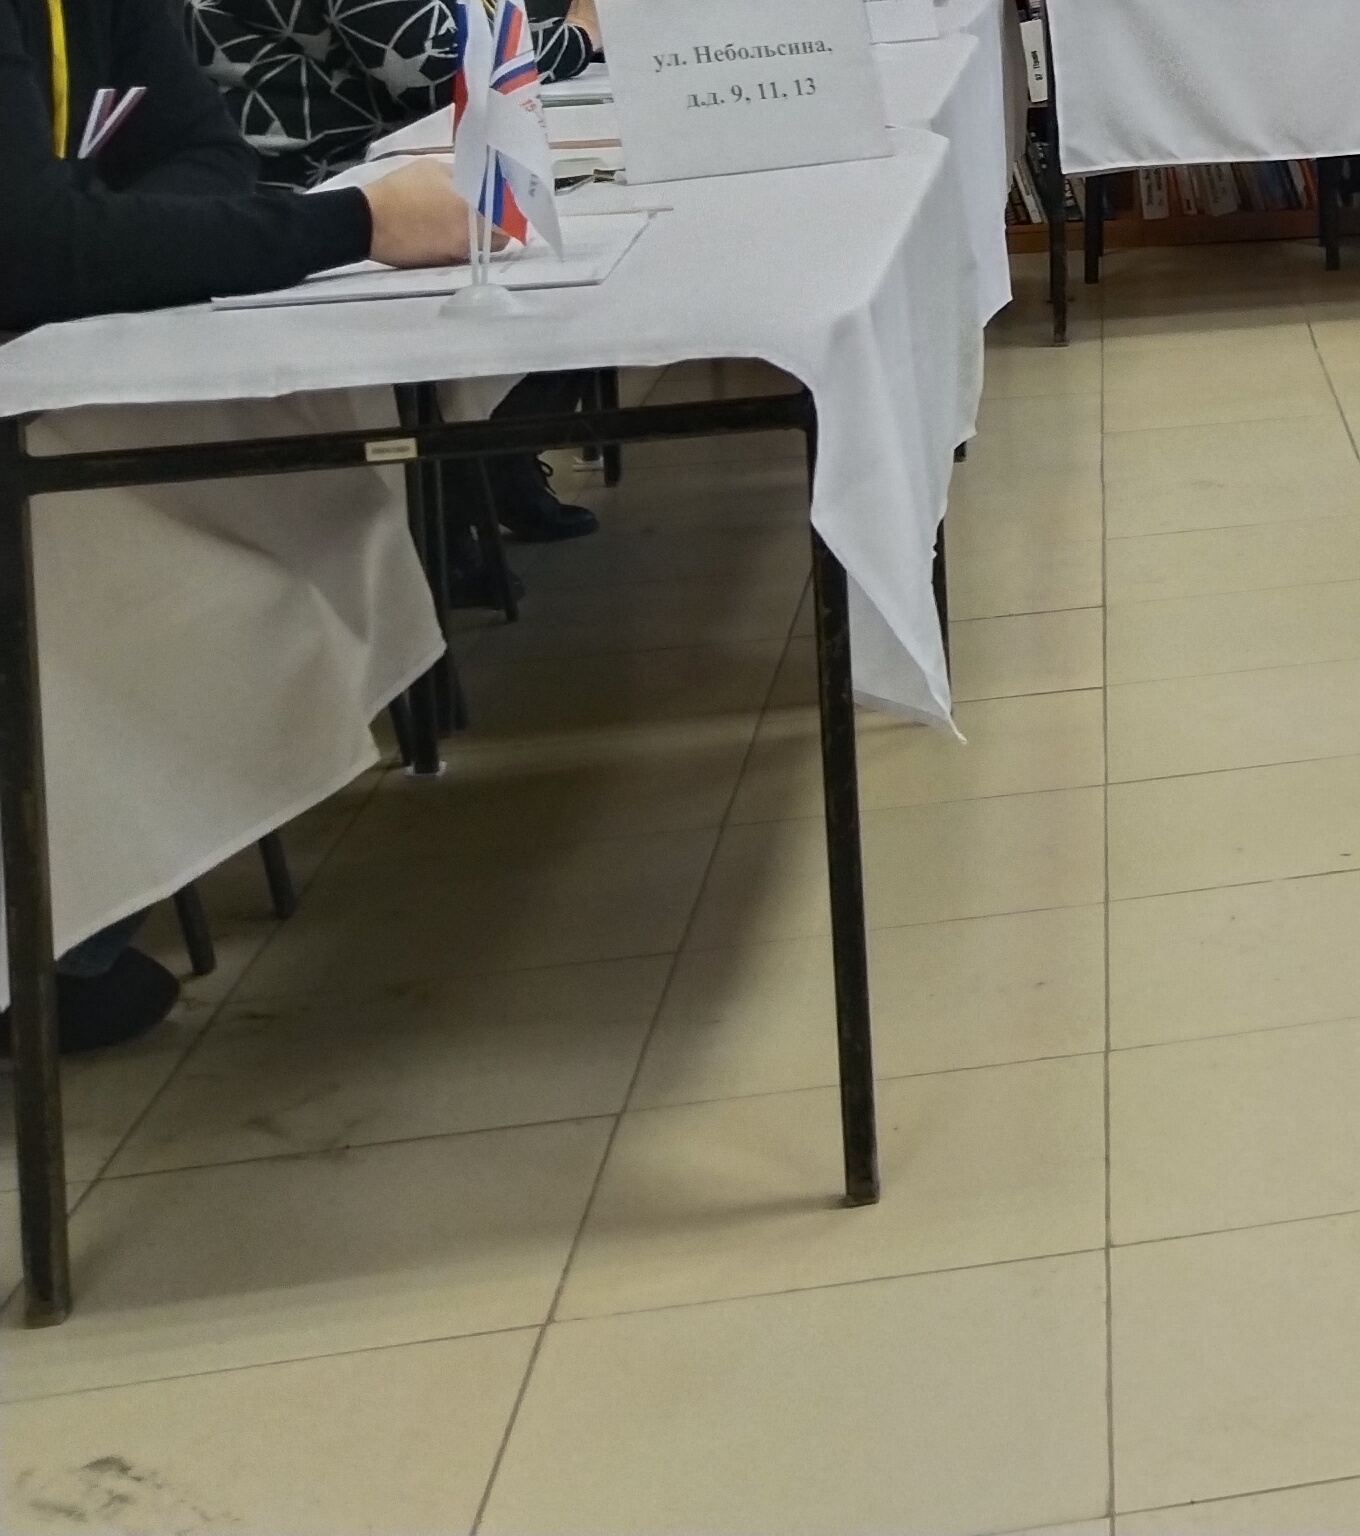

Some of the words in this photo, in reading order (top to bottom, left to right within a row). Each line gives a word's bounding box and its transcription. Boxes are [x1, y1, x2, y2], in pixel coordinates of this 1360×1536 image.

[652, 53, 687, 73] ул.
[693, 40, 833, 65] Небольсина,
[687, 92, 725, 109] д.д.
[730, 83, 751, 103] 9,
[757, 81, 788, 102] 11,
[794, 77, 817, 97] 13
